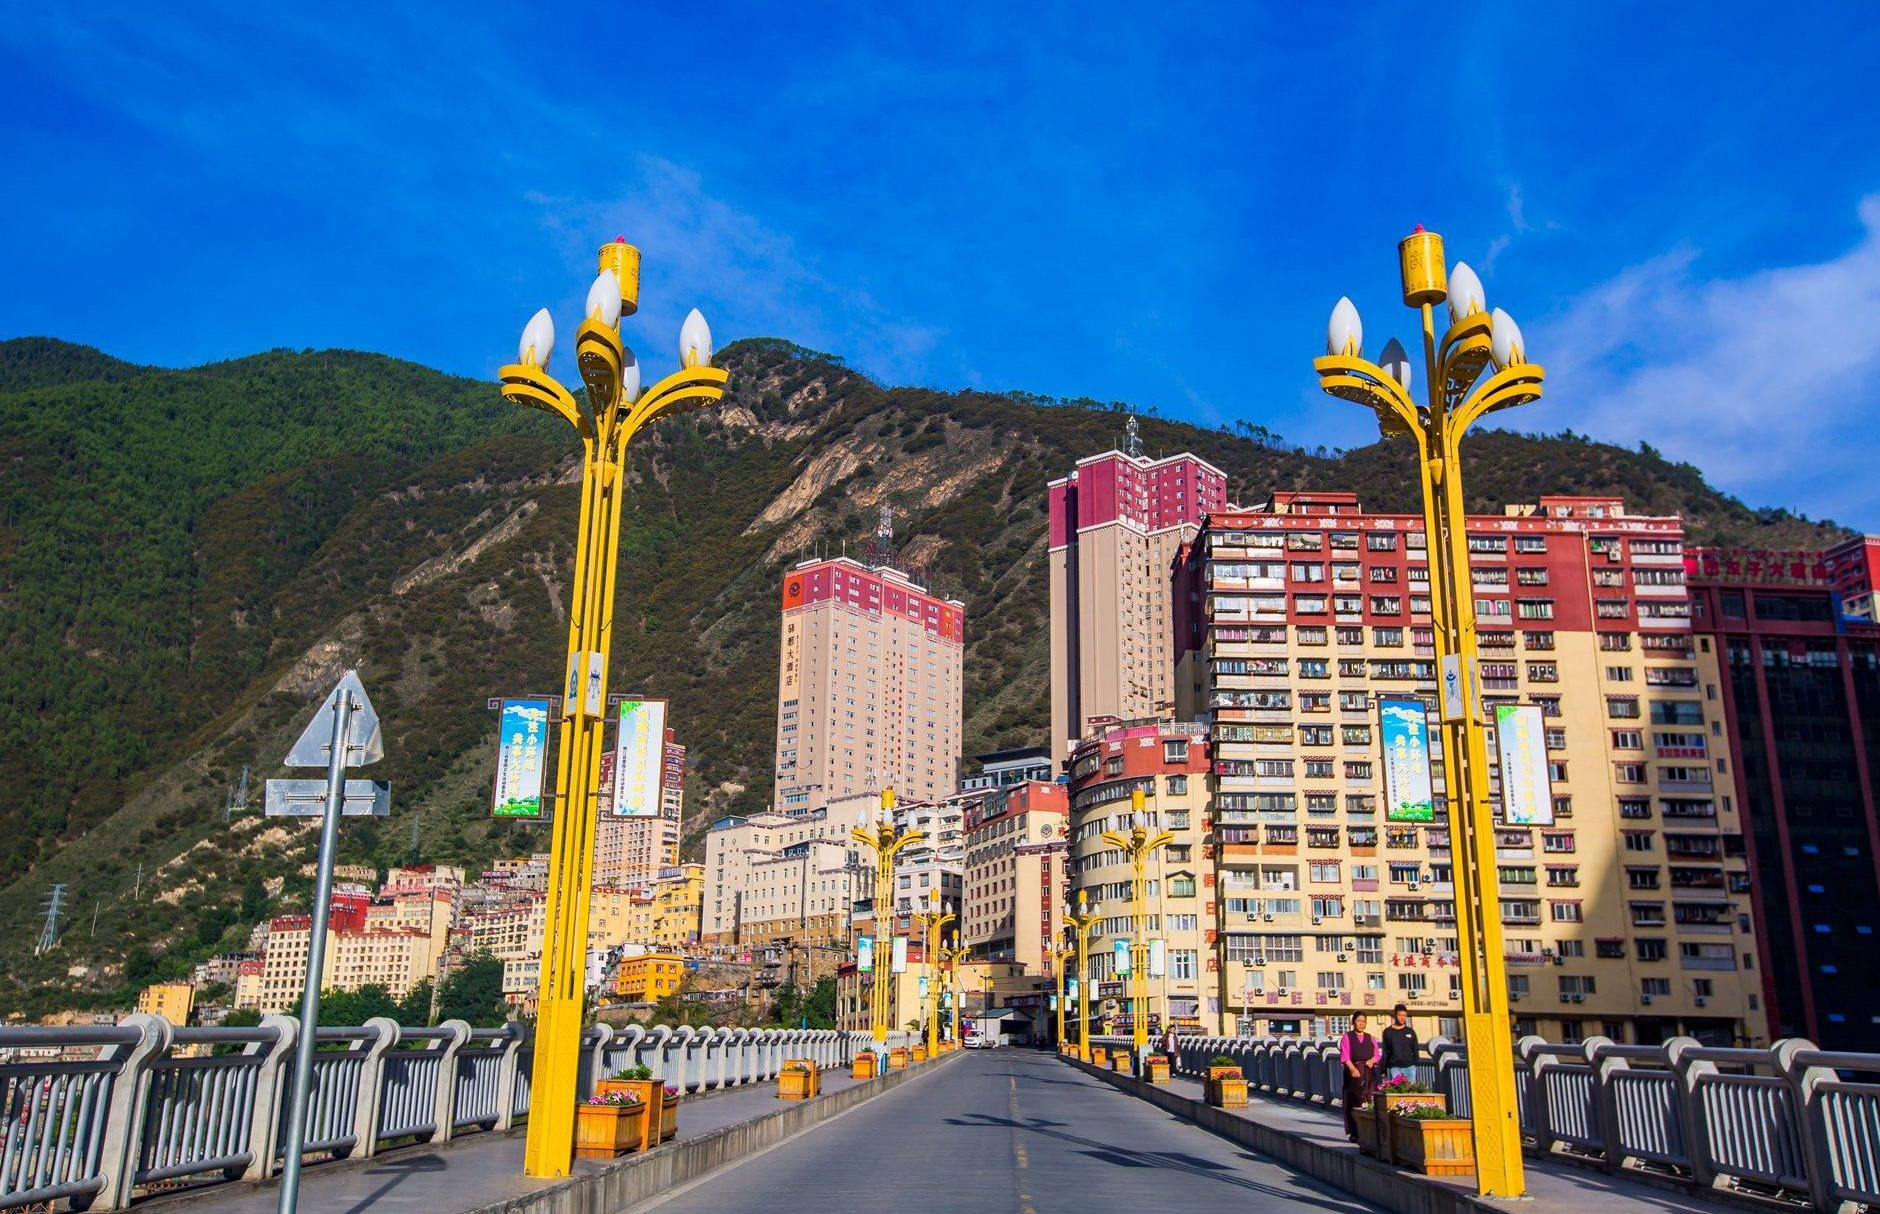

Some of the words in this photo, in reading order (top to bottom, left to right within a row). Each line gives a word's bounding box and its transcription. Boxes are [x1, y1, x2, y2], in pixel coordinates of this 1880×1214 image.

[1200, 818, 1219, 973] 雅江假日酒店
